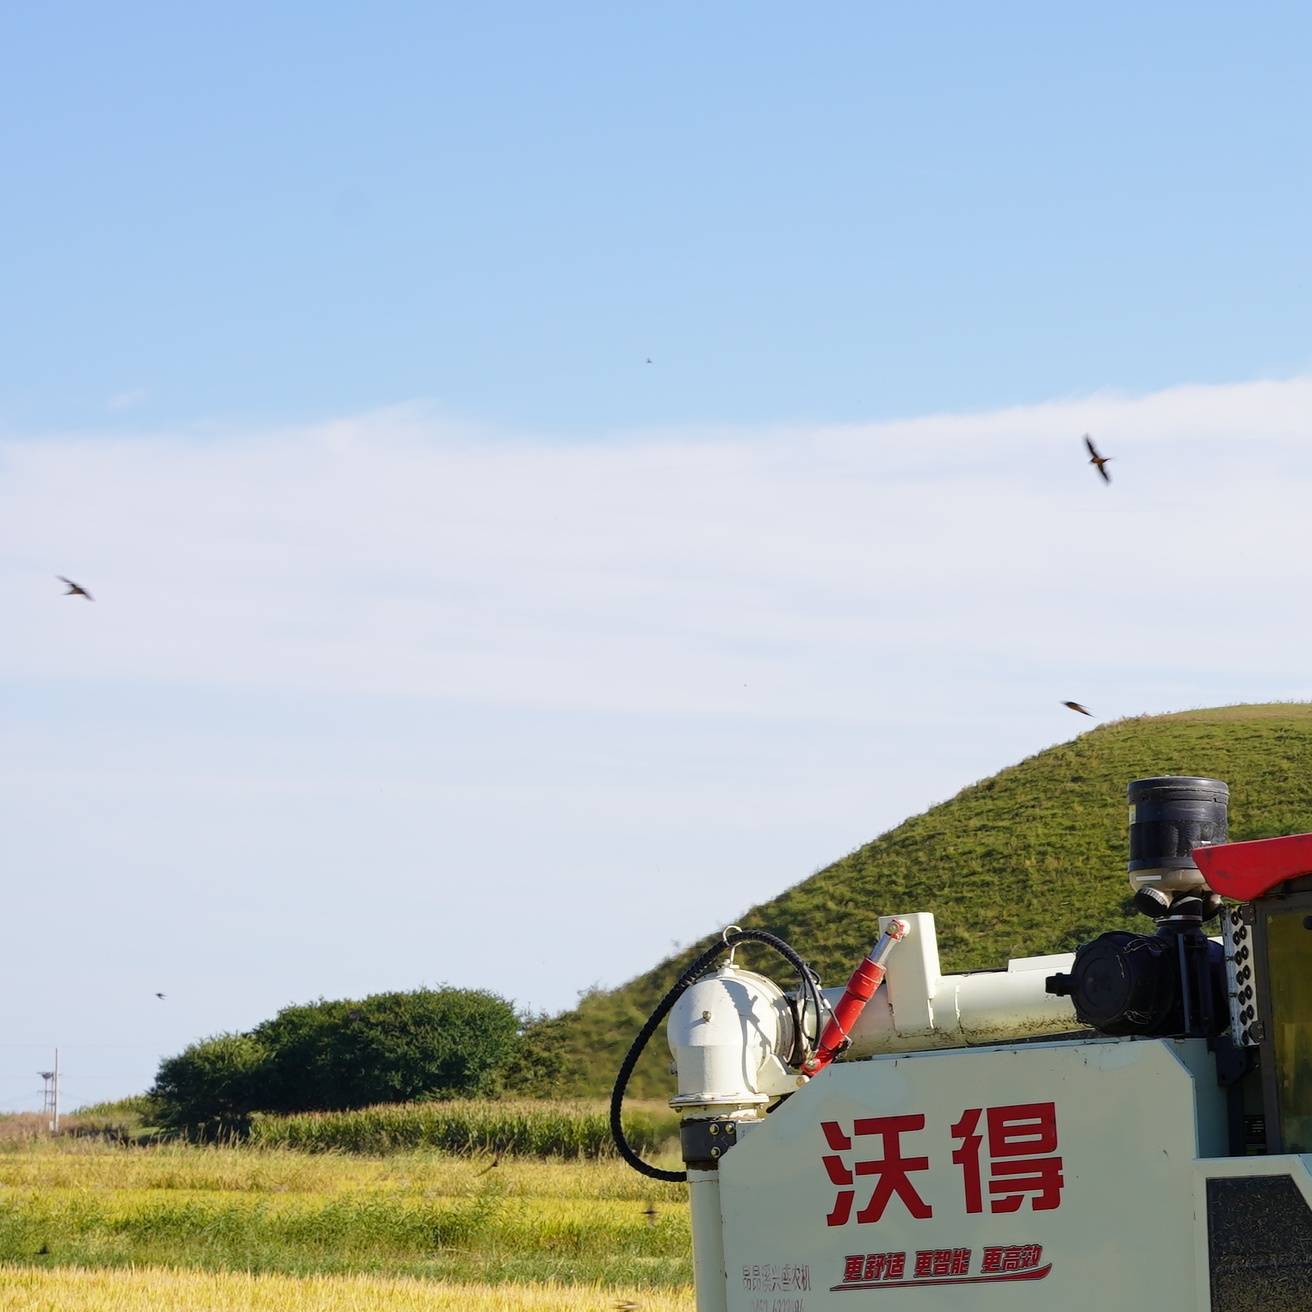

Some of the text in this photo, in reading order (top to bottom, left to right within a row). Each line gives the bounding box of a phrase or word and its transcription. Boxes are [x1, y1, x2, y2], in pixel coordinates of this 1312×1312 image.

[820, 1101, 1065, 1227] 沃得
[843, 1243, 1043, 1283] 更舒适 更智能 更高效
